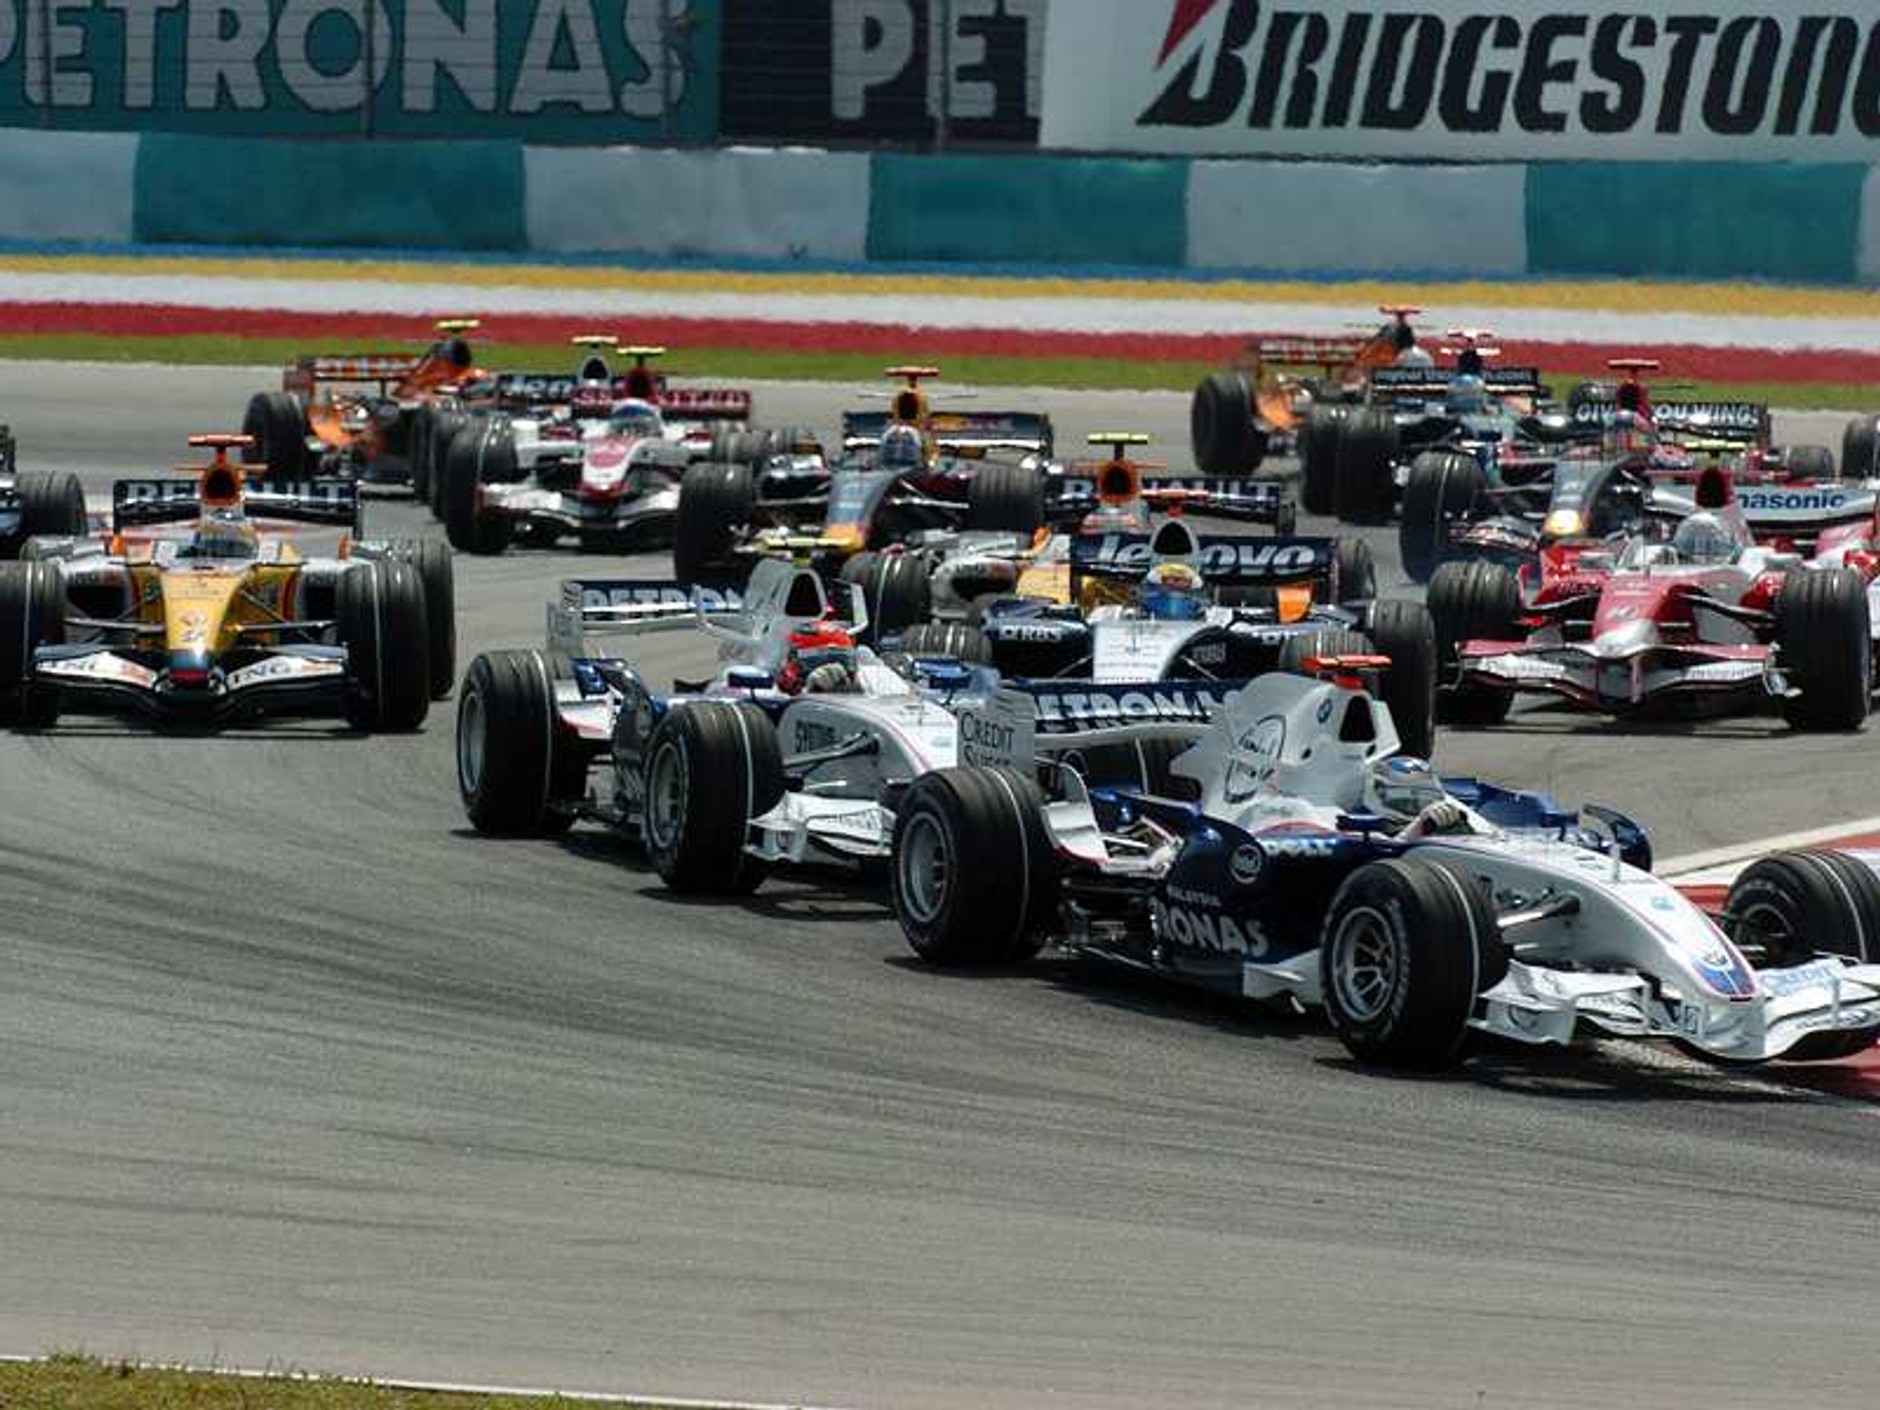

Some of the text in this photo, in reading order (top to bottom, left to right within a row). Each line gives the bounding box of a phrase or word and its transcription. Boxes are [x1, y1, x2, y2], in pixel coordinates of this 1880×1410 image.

[126, 482, 352, 502] REULT
[1060, 480, 1279, 501] RAULT
[1737, 493, 1844, 509] nasonic
[1098, 534, 1316, 576] leovo
[583, 588, 750, 612] PETRON
[1035, 690, 1240, 721] ETRONA
[960, 711, 1015, 748] CREDIT
[1149, 899, 1269, 957] RONAS
